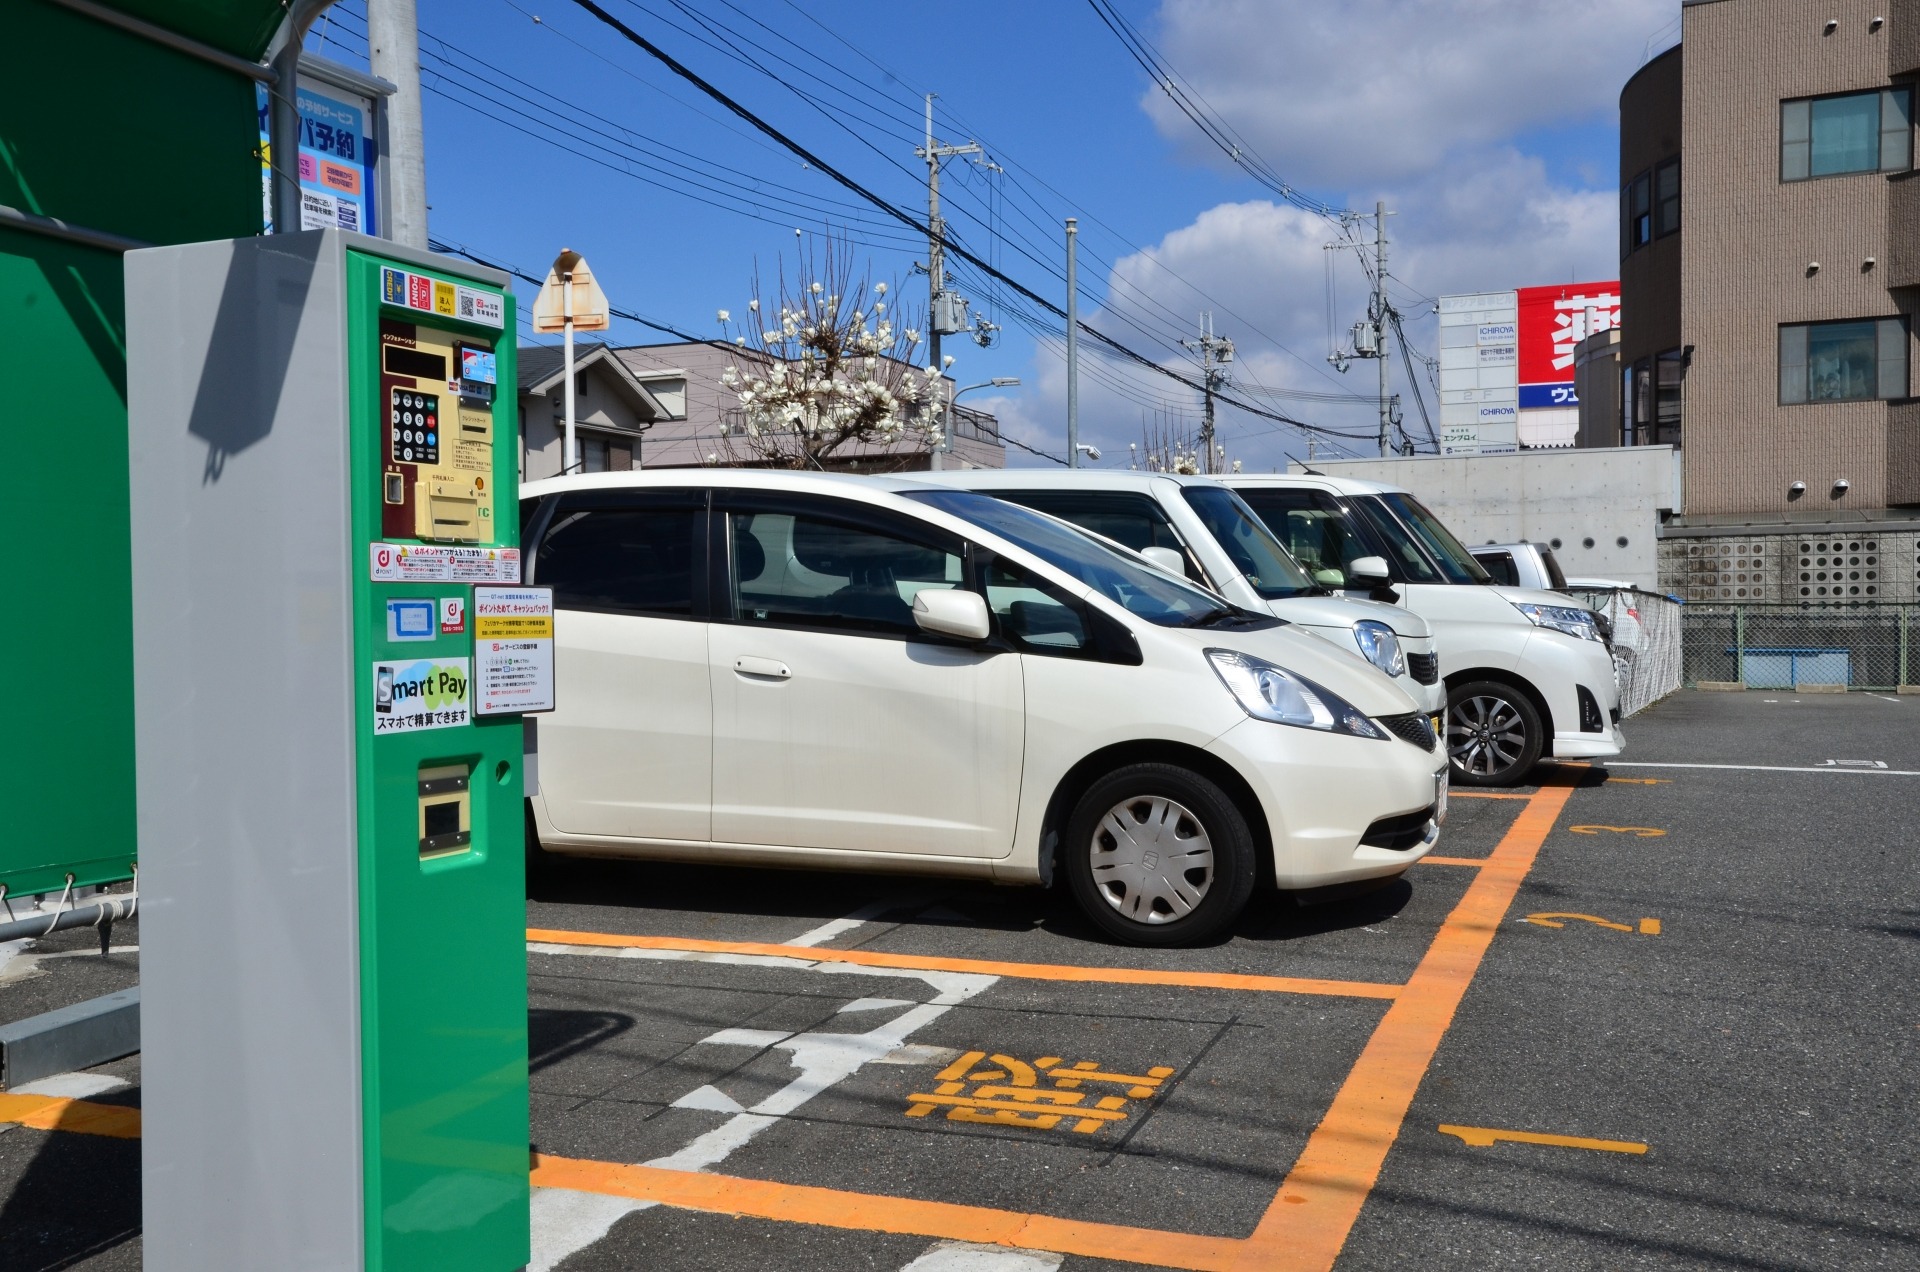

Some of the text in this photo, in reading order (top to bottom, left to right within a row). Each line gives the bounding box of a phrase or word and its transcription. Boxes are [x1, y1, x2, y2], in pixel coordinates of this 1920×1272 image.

[386, 271, 394, 302] CREDIT
[411, 275, 419, 307] POINT
[439, 305, 451, 314] Card
[1479, 326, 1515, 335] ICHIROYA
[1480, 408, 1516, 416] ICHIROYA
[378, 671, 468, 701] Smart Pay
[377, 710, 467, 730] スマホで精算できます
[1568, 825, 1668, 838] 3
[1523, 911, 1661, 935] 2
[904, 1051, 1175, 1134] 軽
[1437, 1124, 1648, 1155] 1
